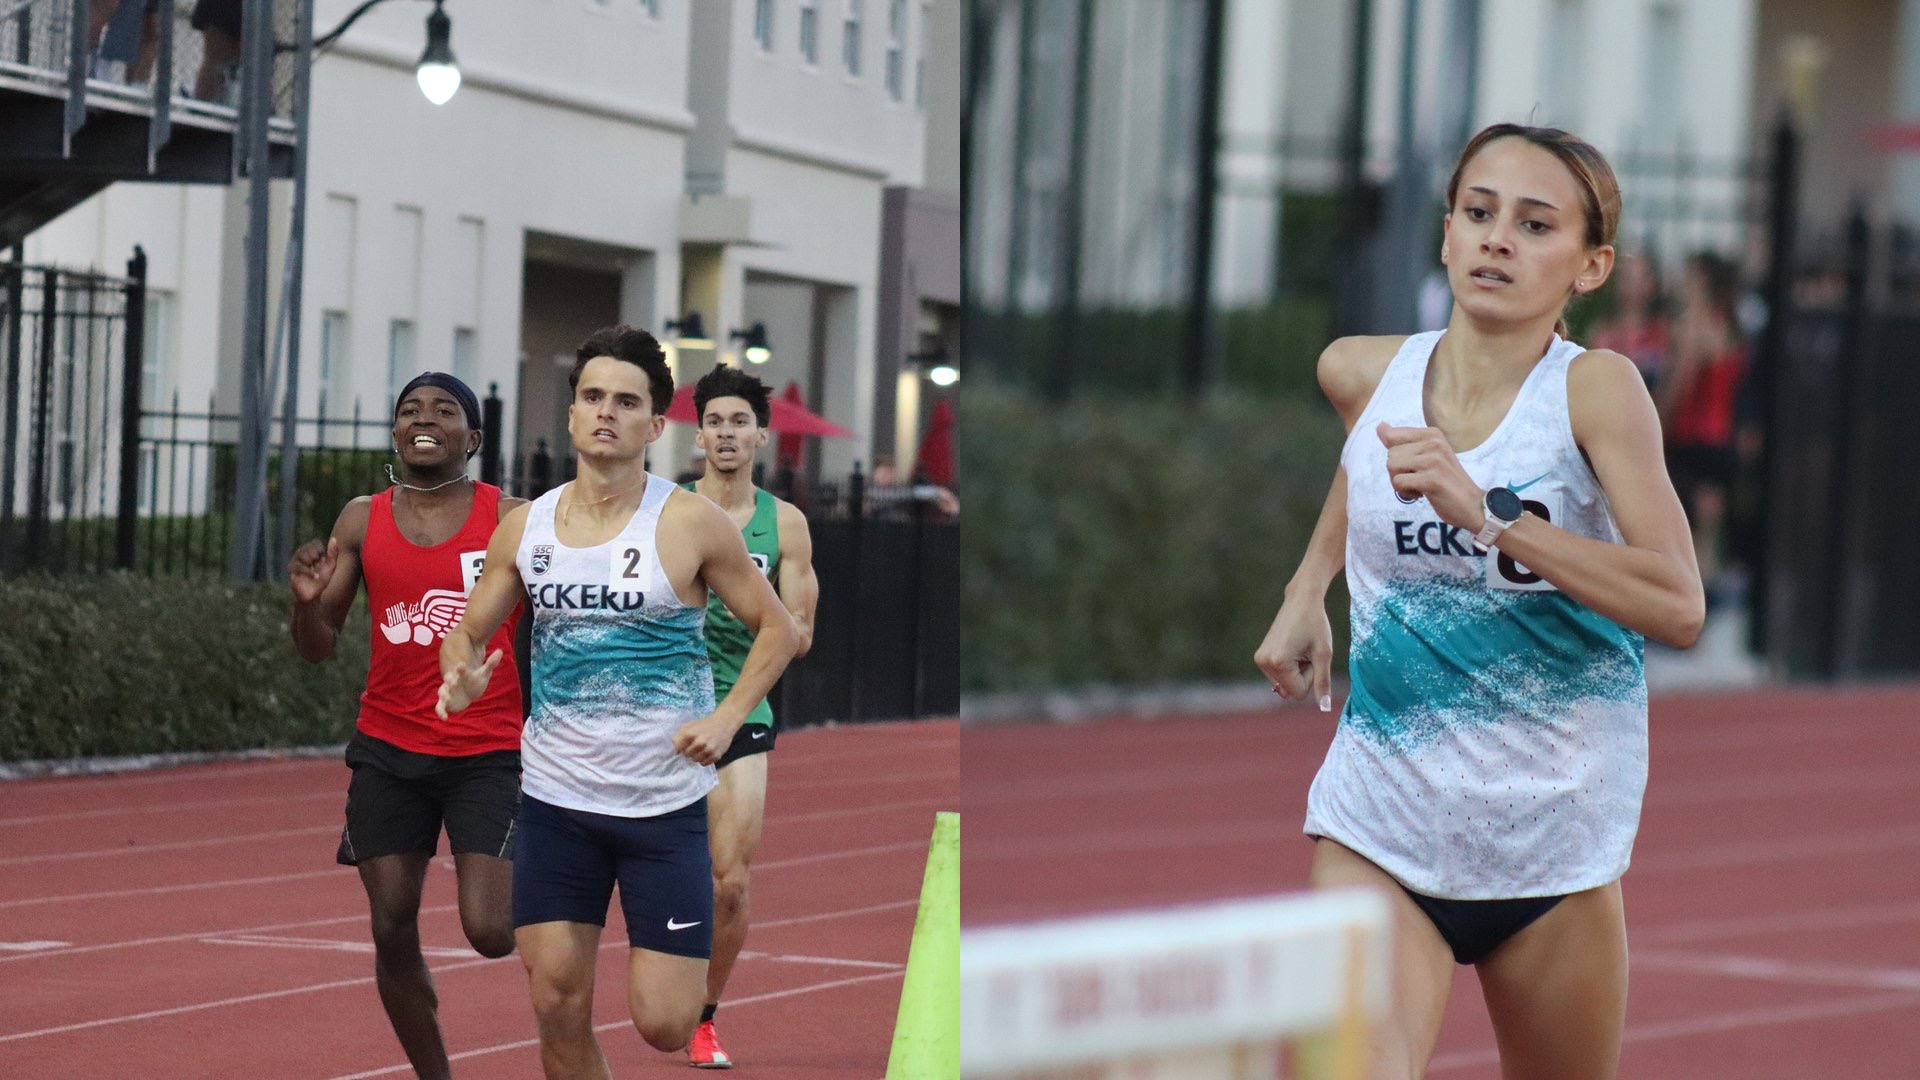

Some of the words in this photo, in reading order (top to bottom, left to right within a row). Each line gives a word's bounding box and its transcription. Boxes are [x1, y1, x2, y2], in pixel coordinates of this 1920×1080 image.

[533, 546, 552, 554] SSC
[1393, 520, 1487, 556] ECK
[622, 547, 641, 579] 2
[528, 583, 645, 612] ECKERD
[385, 601, 408, 627] BING
[407, 602, 421, 621] fit
